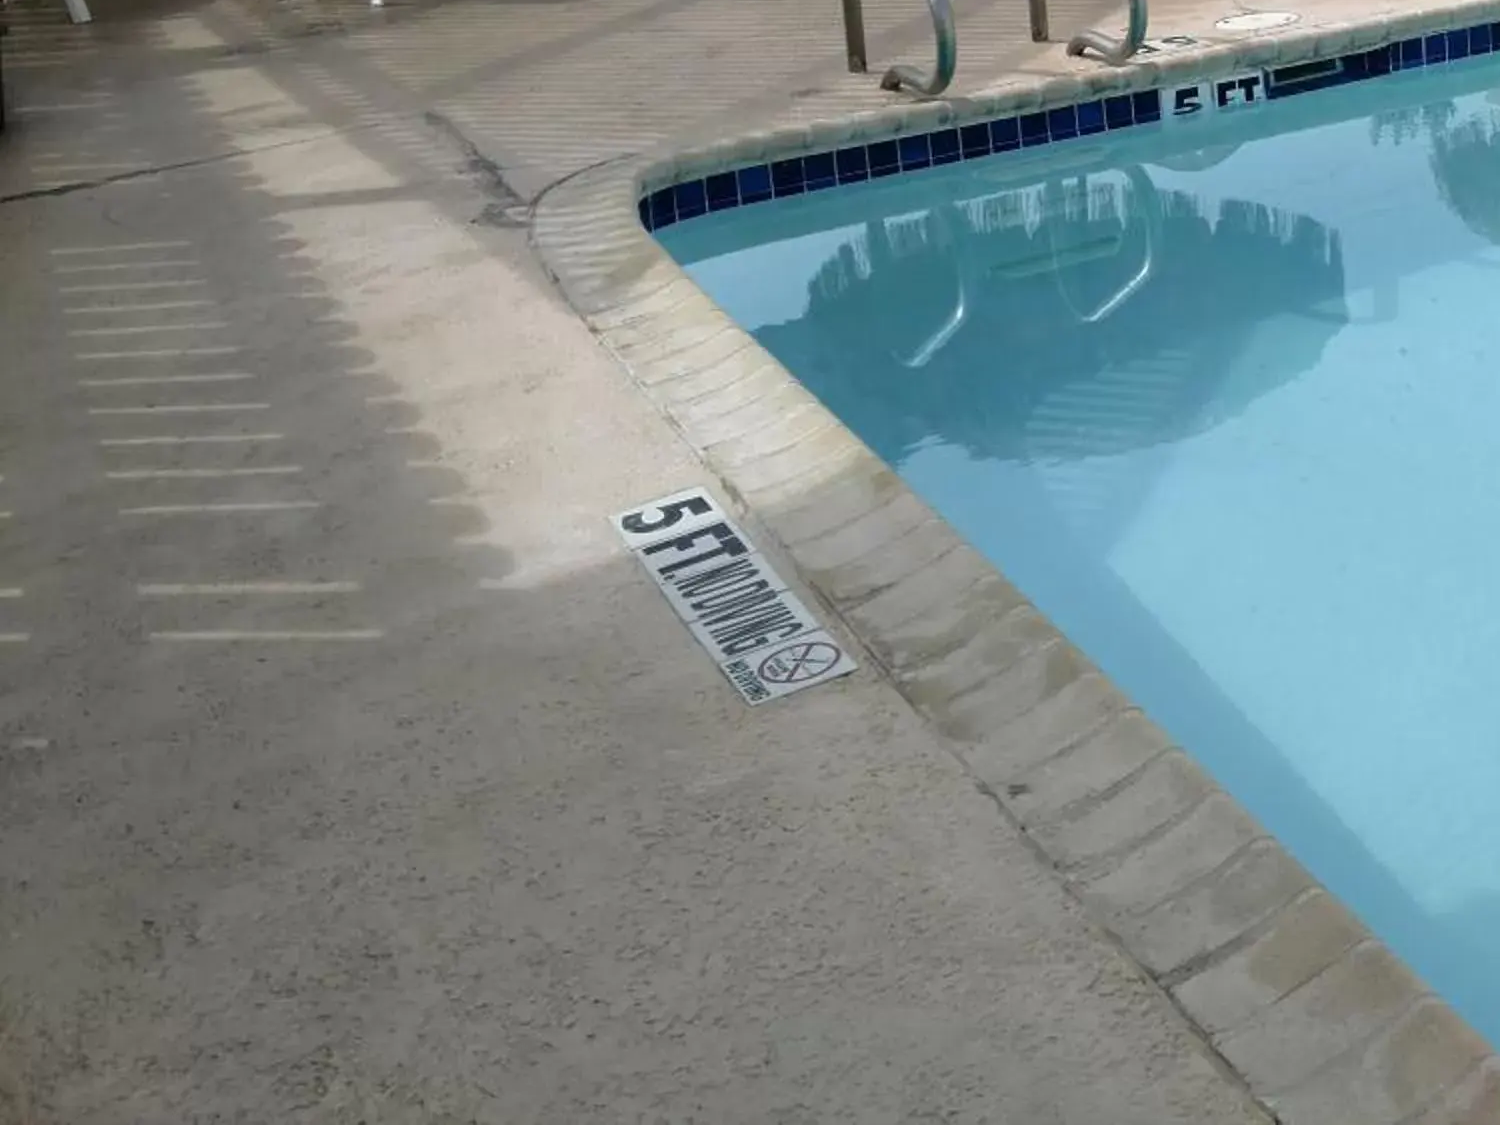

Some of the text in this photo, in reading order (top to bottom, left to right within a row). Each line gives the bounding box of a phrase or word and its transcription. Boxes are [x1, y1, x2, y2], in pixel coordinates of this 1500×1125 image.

[1173, 86, 1203, 115] 5
[621, 496, 712, 533] 5
[673, 558, 760, 598] NO
[690, 579, 803, 656] DIVING
